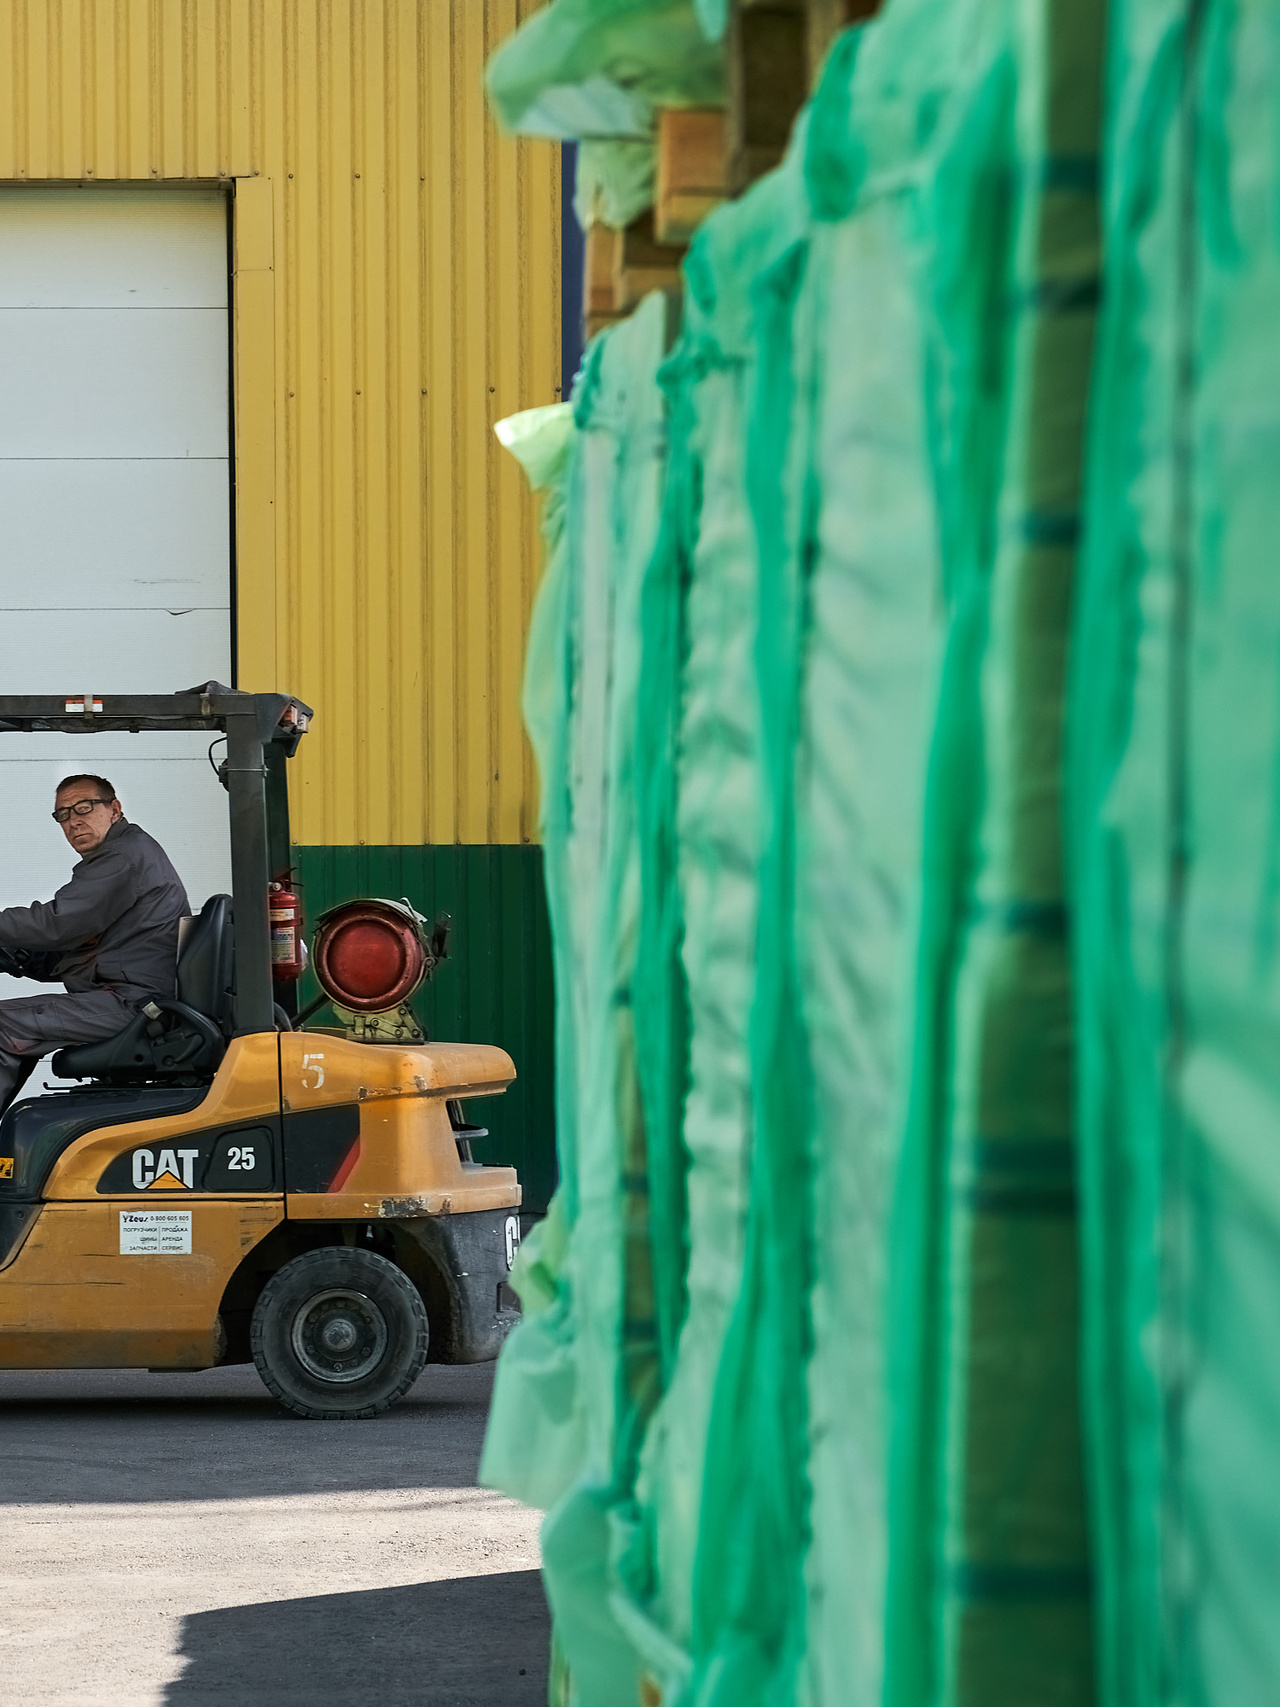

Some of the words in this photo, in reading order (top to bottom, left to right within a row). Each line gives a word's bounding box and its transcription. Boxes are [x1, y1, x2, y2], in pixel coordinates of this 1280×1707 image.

[301, 1053, 325, 1090] 5
[132, 1148, 199, 1190] CAT
[227, 1146, 256, 1171] 25
